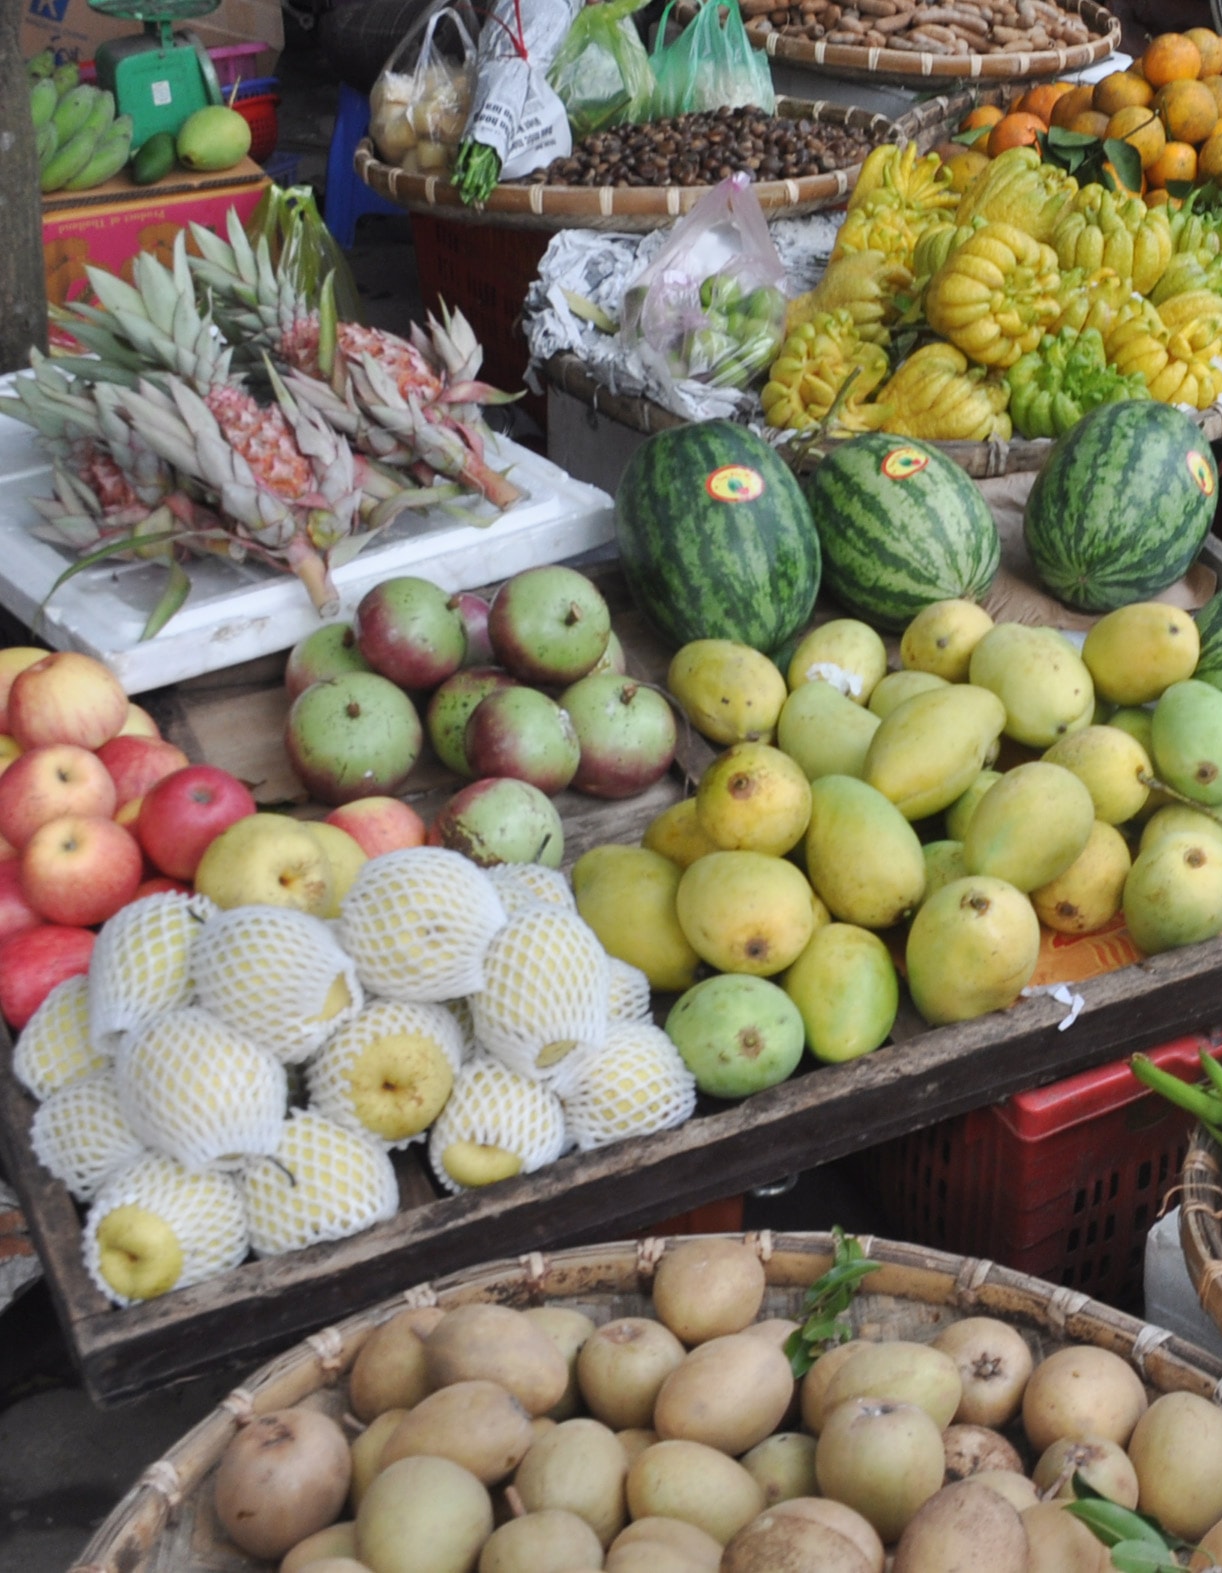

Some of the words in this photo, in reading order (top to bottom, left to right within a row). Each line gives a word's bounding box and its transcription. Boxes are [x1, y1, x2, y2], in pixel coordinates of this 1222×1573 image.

[110, 216, 121, 227] of
[125, 209, 166, 222] Product
[58, 218, 106, 233] Thailand
